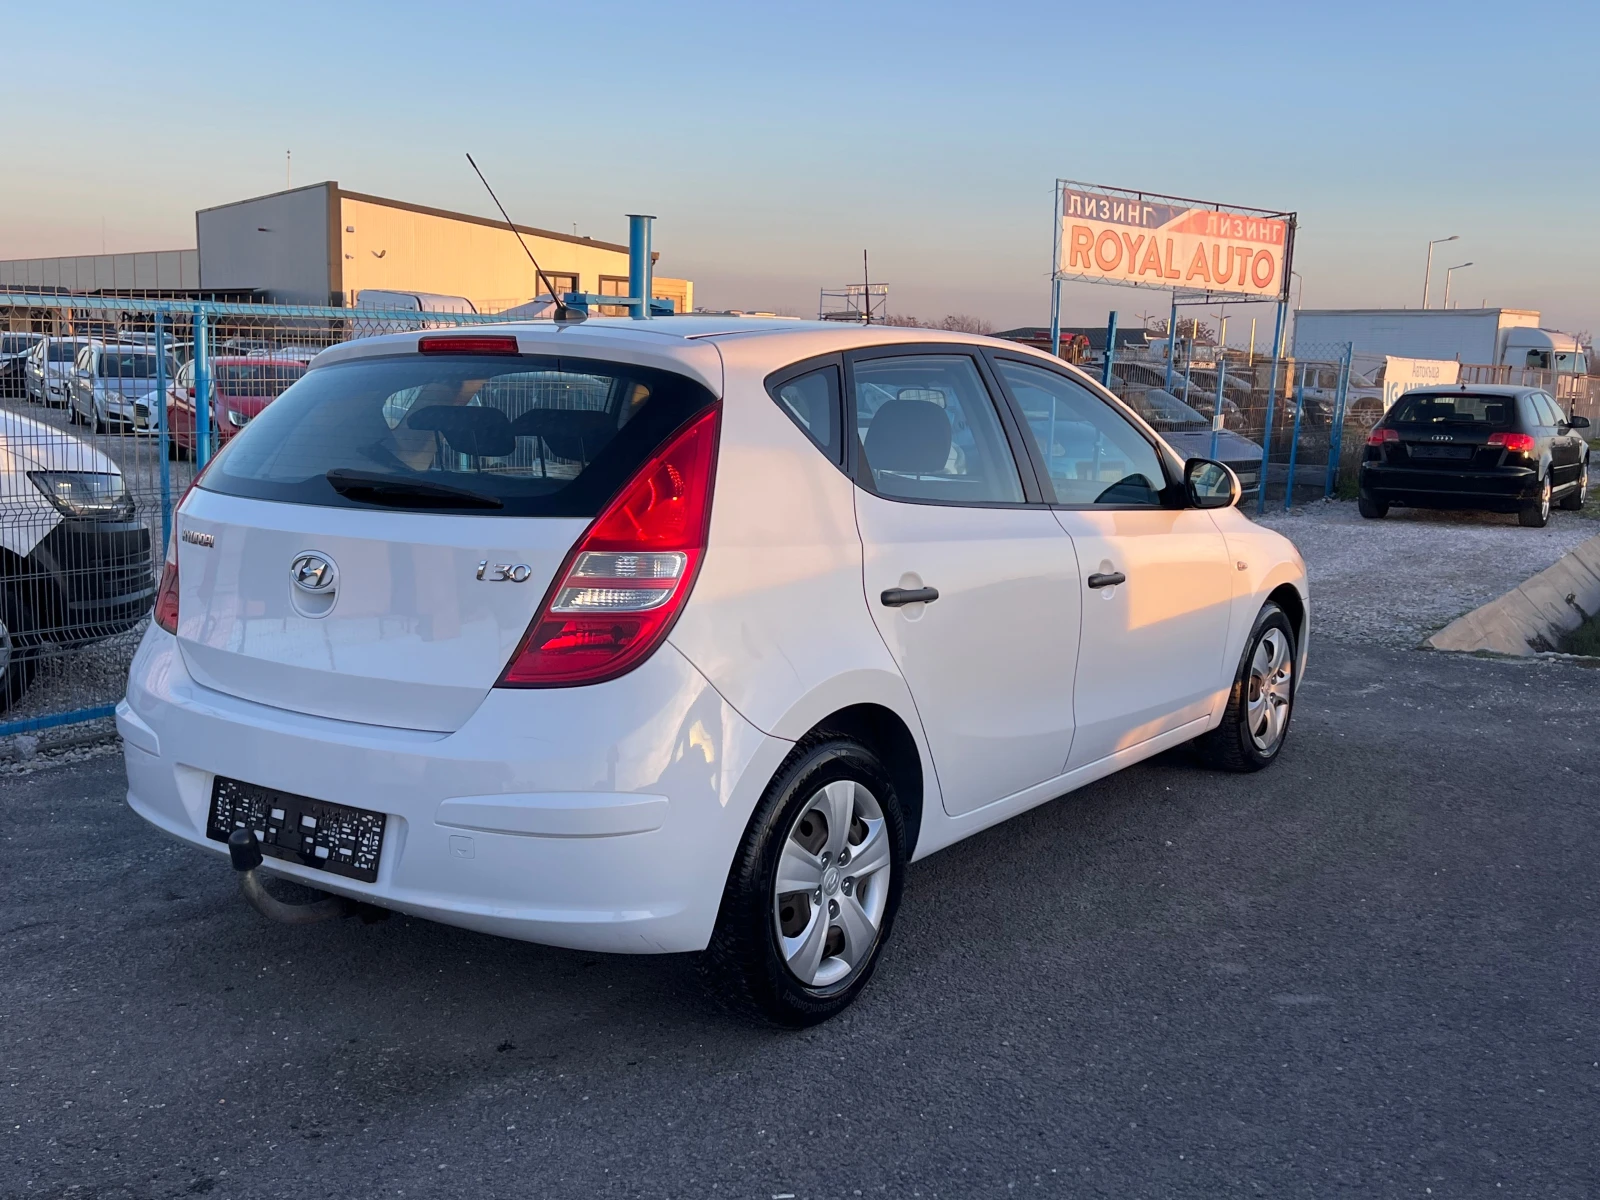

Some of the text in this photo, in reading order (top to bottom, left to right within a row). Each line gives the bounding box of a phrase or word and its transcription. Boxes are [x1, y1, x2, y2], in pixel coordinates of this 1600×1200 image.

[1068, 194, 1153, 225] ЛИЗИНГ
[1206, 216, 1282, 242] ЛИЗИНГ
[1069, 225, 1275, 288] ROYAL AUTO
[1386, 380, 1399, 406] IG
[182, 528, 215, 549] HYUNDAI
[476, 560, 532, 583] i30
